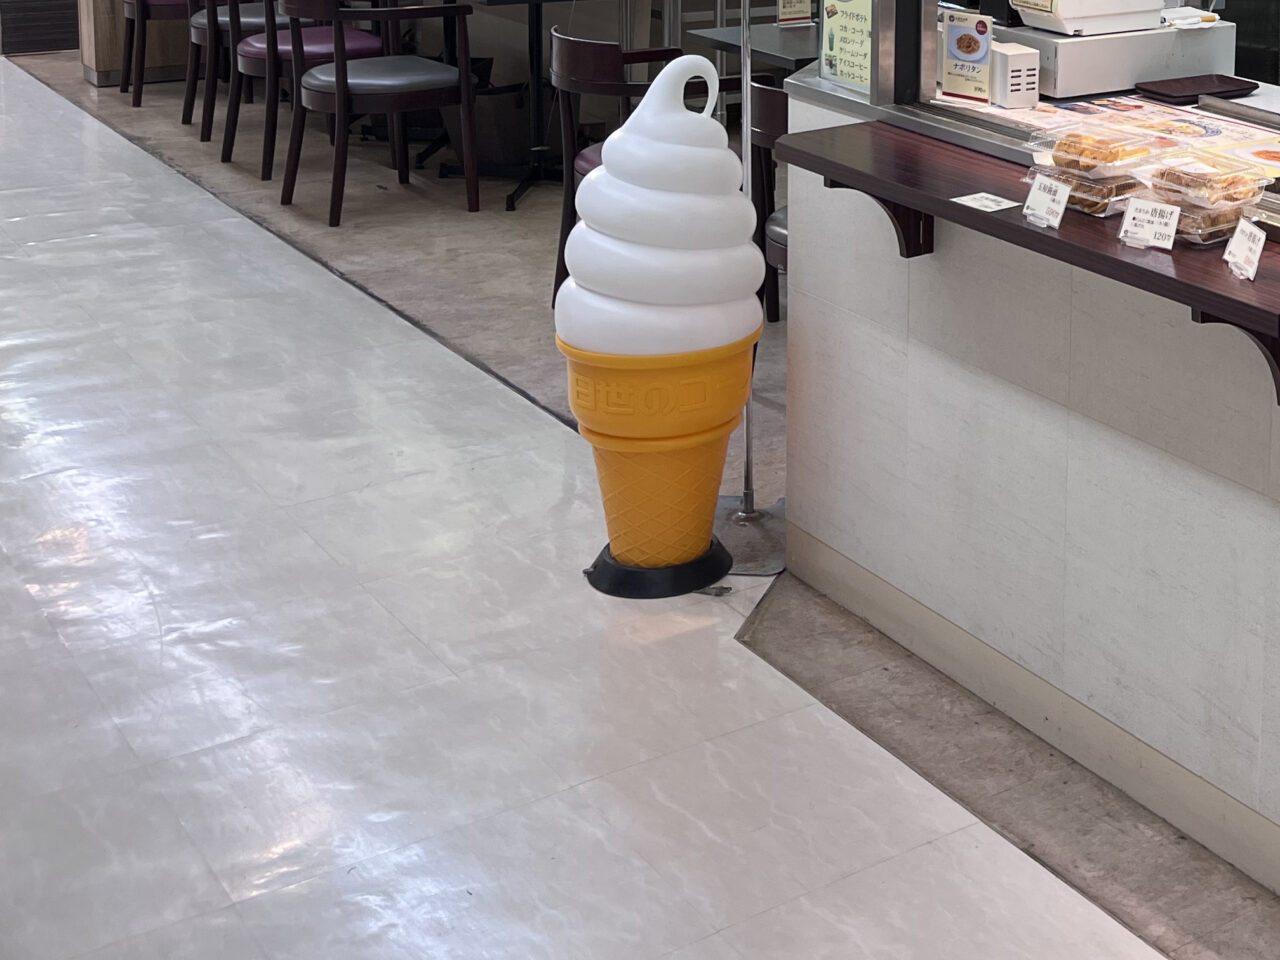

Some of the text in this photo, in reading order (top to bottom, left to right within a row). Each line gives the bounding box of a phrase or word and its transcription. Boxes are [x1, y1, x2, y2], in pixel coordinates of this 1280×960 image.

[840, 10, 868, 23] フライドポテト
[952, 63, 982, 74] ナポリタン
